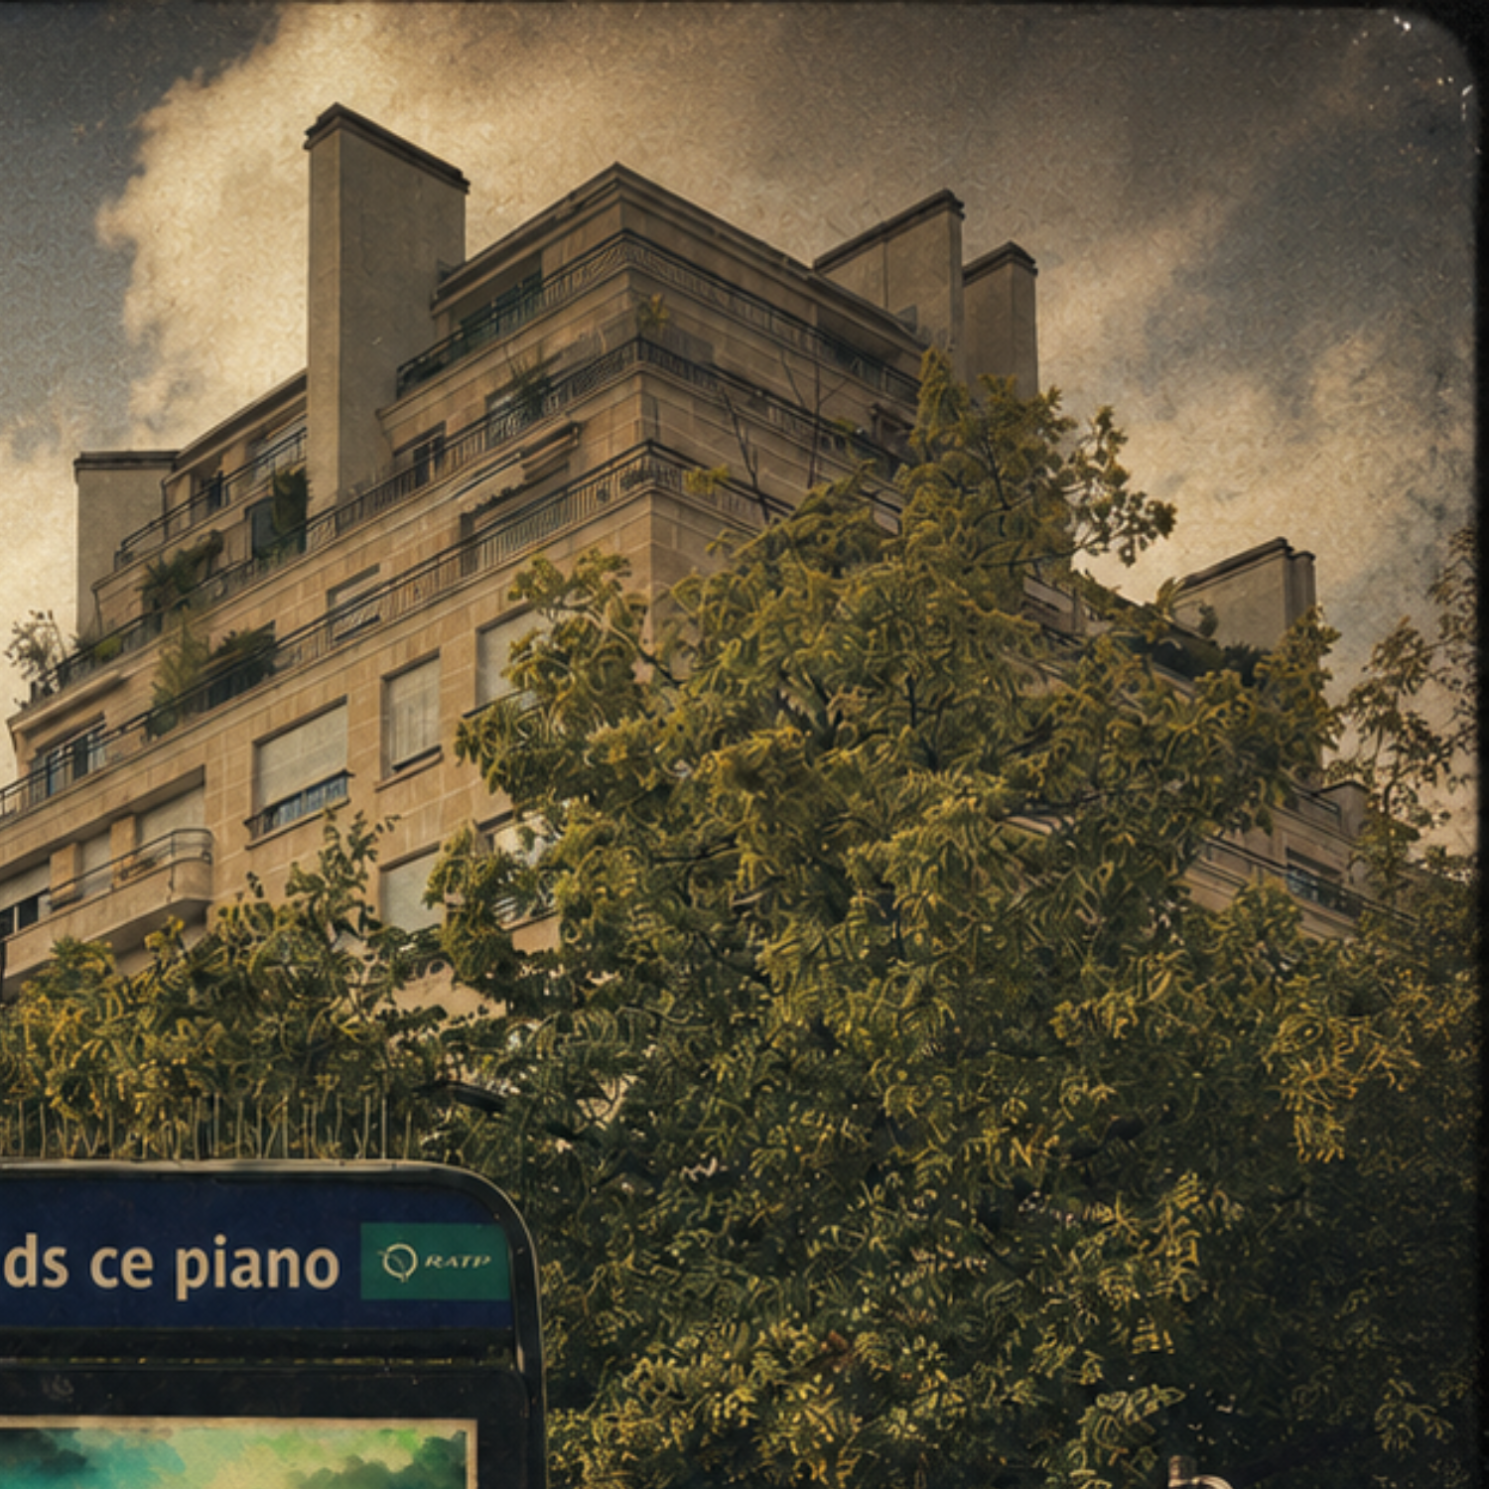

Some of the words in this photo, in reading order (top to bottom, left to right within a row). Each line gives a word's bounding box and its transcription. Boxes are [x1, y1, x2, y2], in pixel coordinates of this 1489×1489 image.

[90, 1246, 154, 1290] ce
[175, 1233, 340, 1301] piano
[424, 1254, 492, 1269] RATP
